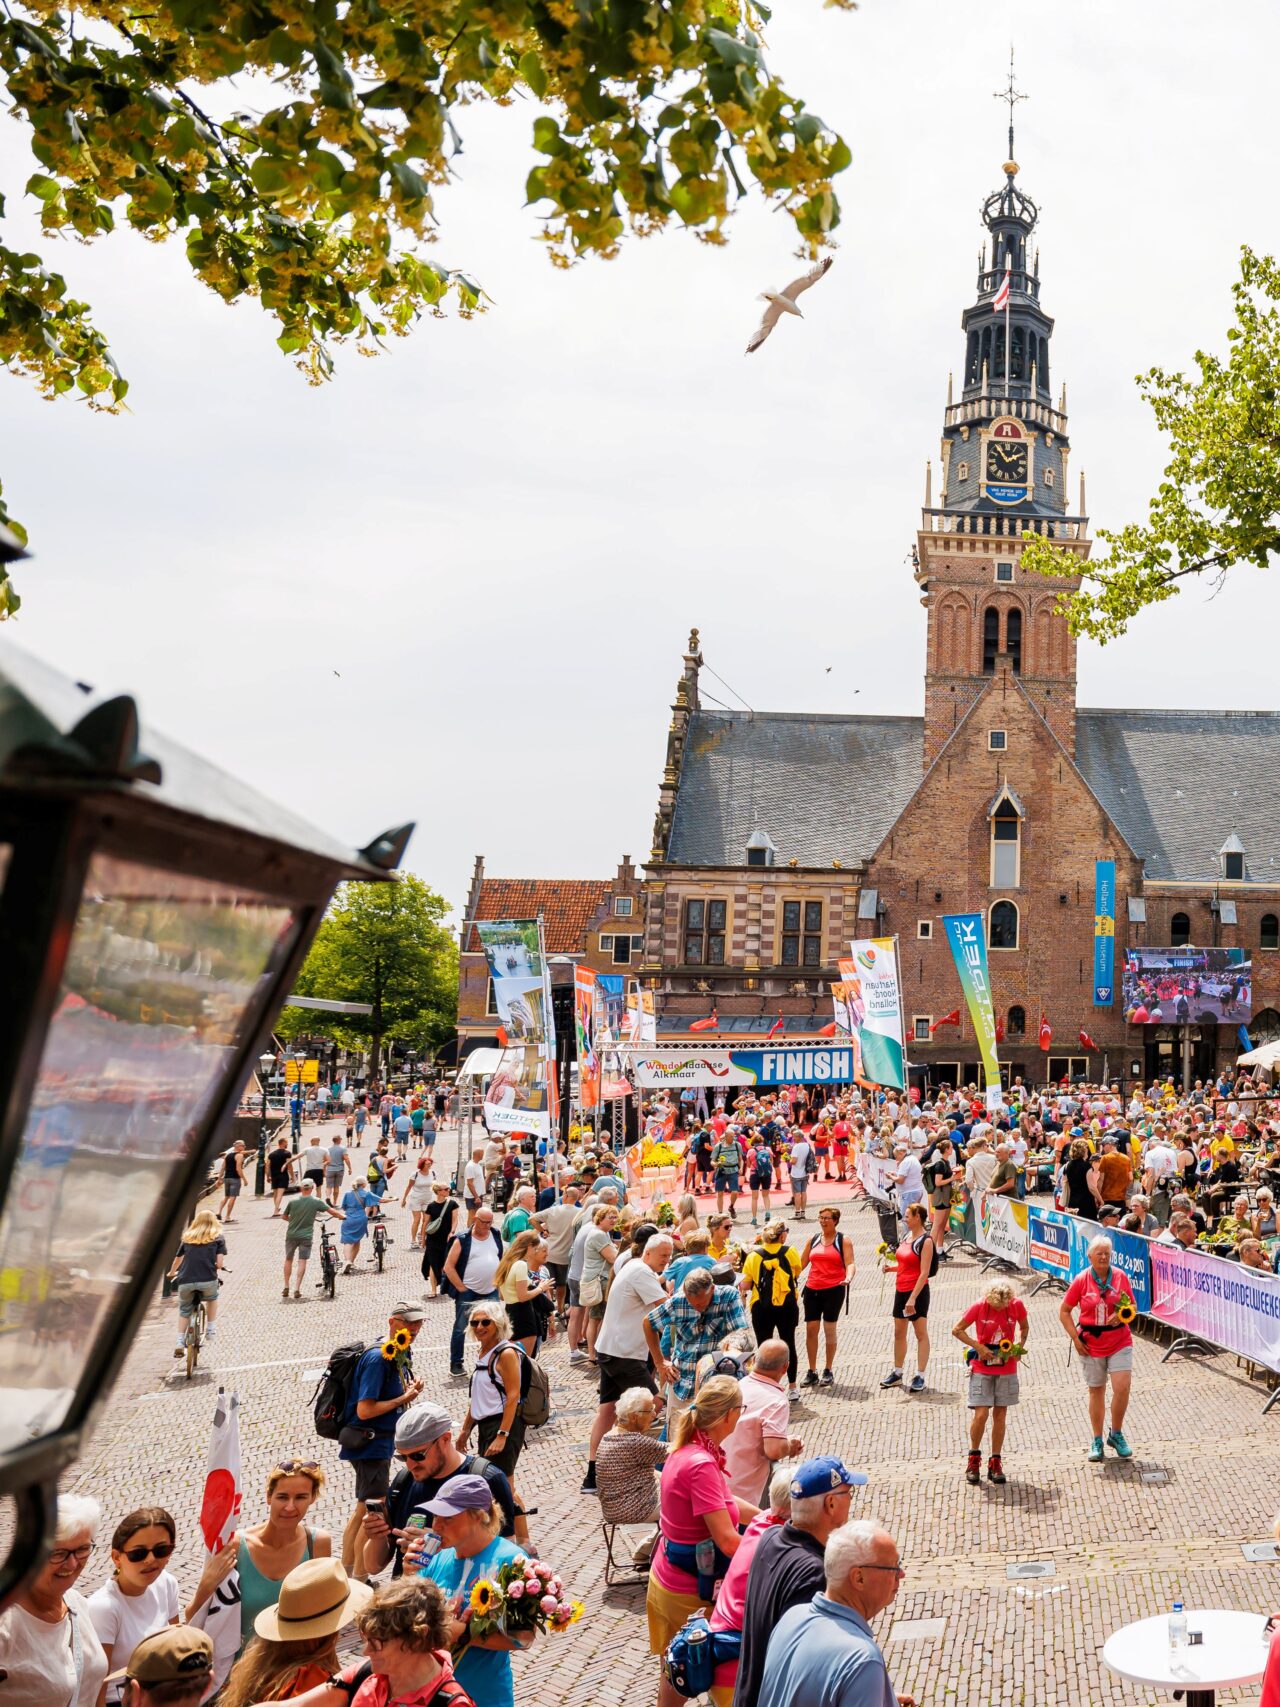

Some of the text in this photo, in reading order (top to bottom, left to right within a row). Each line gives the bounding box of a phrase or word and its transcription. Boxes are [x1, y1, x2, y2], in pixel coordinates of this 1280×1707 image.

[1174, 958, 1194, 967] FINISH
[653, 1070, 696, 1079] Alkmaar
[762, 1051, 849, 1081] FINISH
[1043, 1225, 1058, 1245] DIXI
[1193, 1270, 1222, 1298] SOESTER
